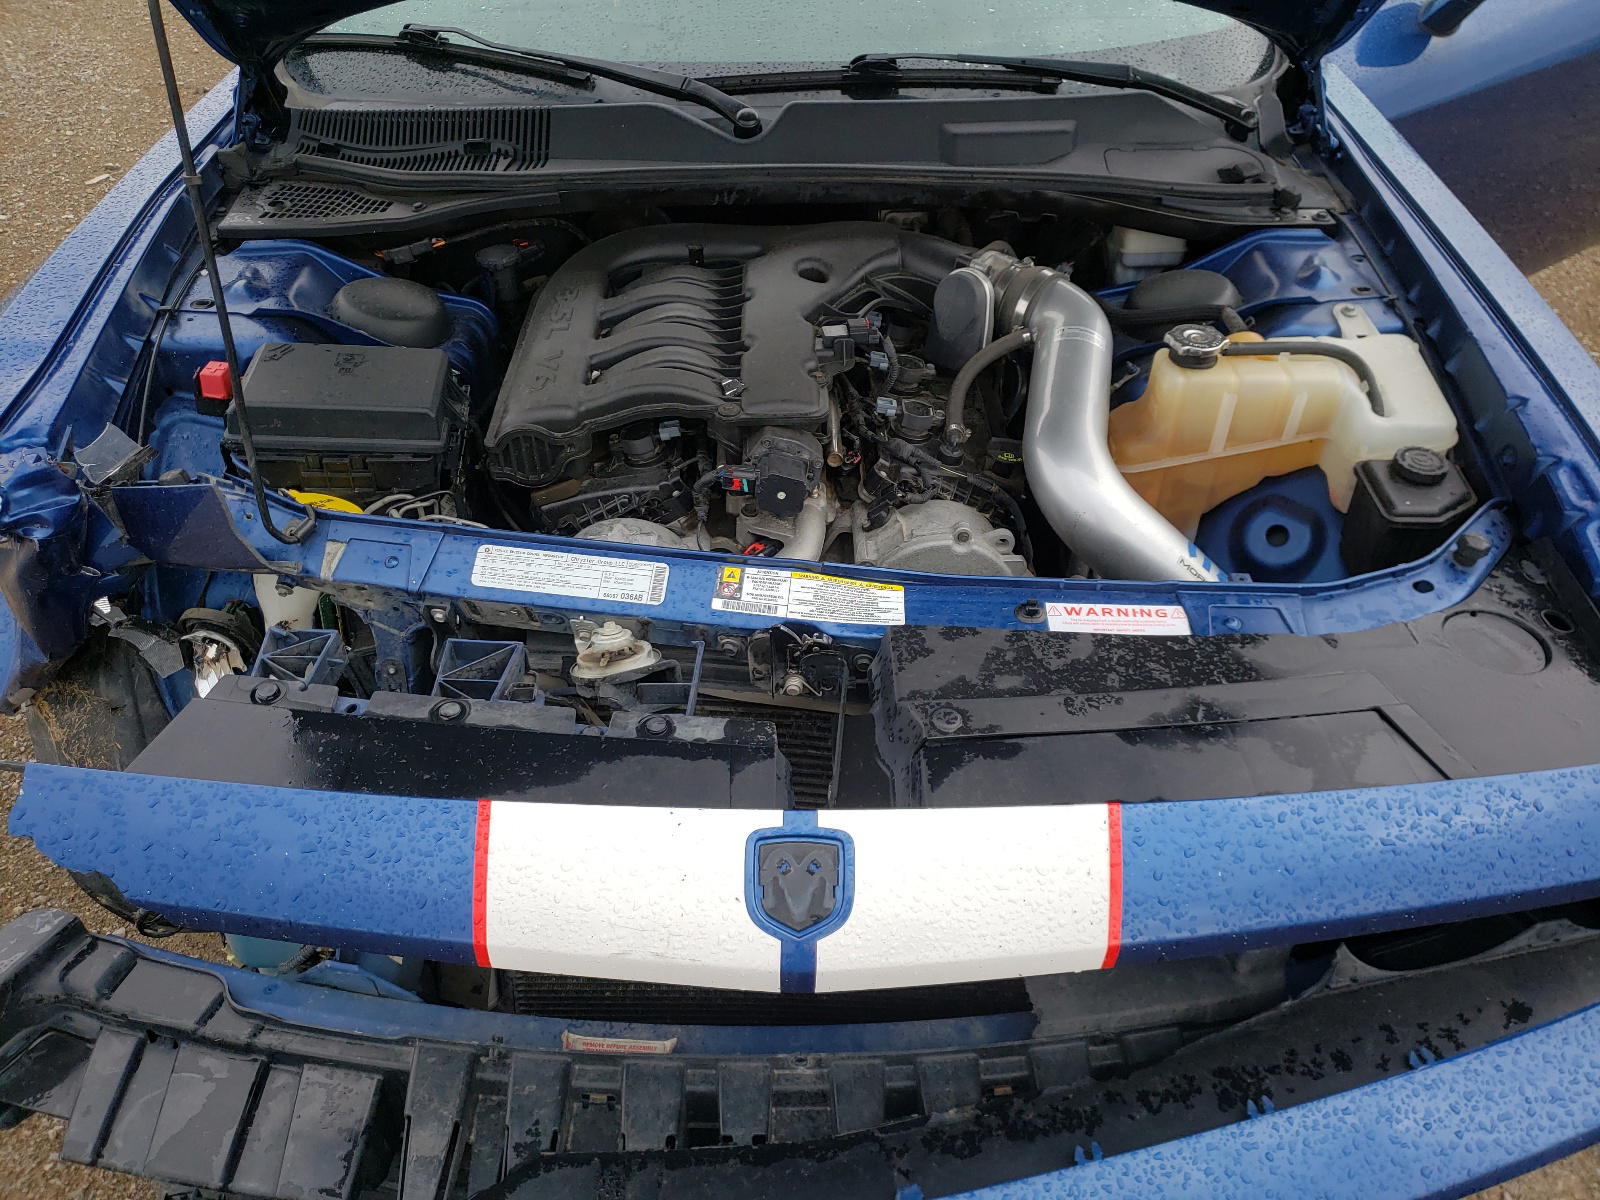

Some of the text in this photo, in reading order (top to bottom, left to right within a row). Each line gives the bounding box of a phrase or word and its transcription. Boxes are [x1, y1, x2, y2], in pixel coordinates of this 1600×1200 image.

[570, 556, 595, 564] Chrysler
[1179, 558, 1208, 583] MOP
[620, 592, 643, 602] 036AB
[1063, 606, 1169, 618] WARNING
